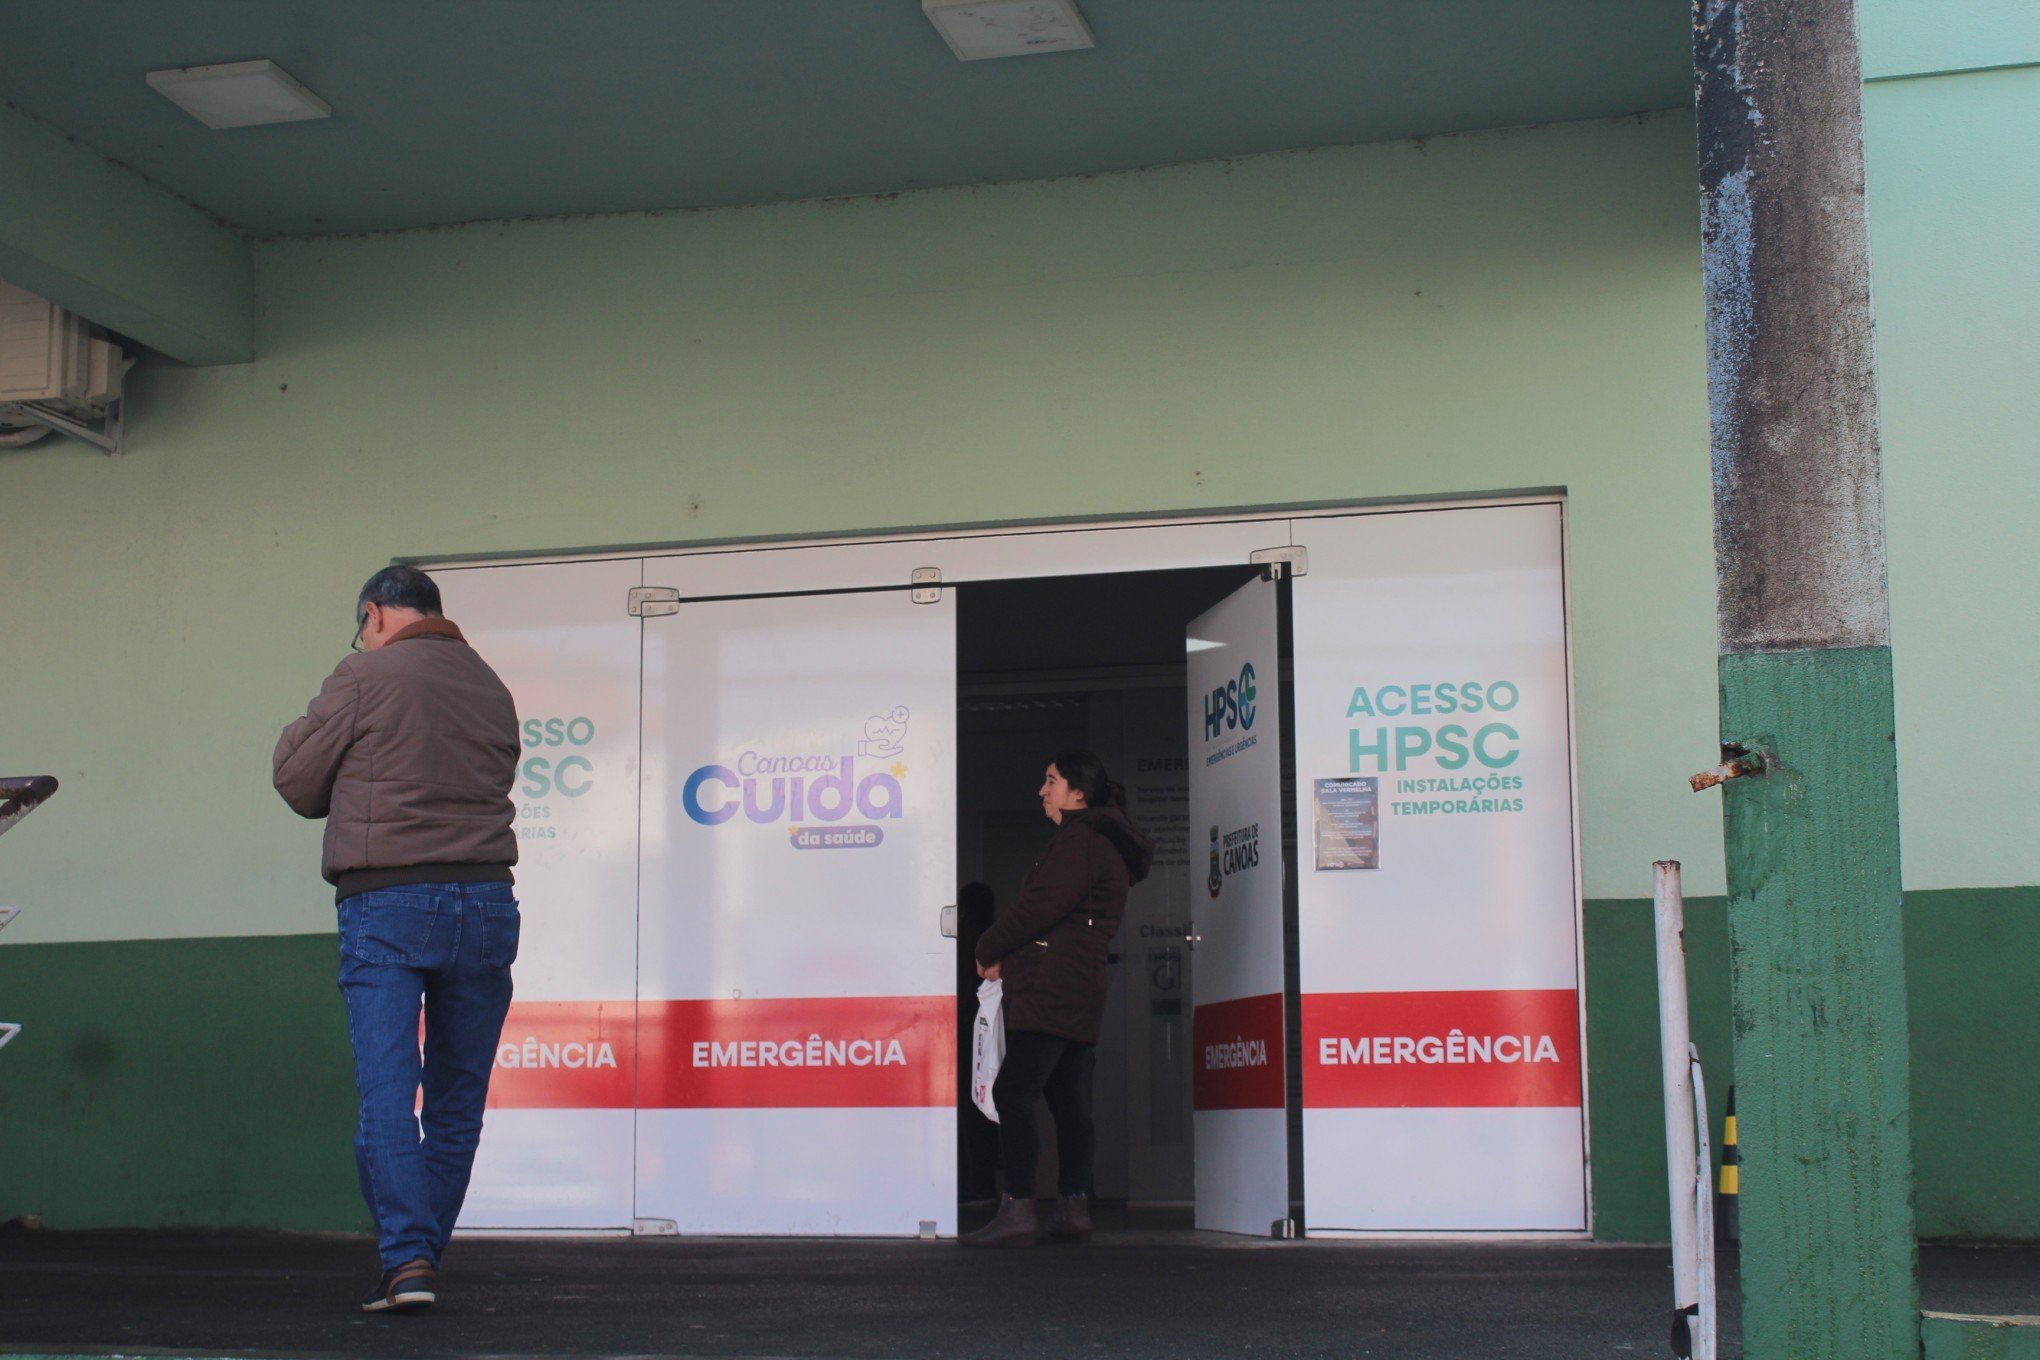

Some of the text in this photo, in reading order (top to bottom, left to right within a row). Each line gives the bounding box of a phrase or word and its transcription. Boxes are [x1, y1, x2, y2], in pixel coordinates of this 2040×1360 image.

[1345, 680, 1520, 718] ACESSO
[517, 716, 595, 748] SSO
[1349, 722, 1521, 773] HPSC
[514, 755, 595, 799] SC
[737, 750, 837, 777] Canoas
[682, 755, 903, 826] Cuida
[1396, 773, 1523, 795] INSTALAÇÕES
[1391, 795, 1524, 816] TEMPORÁRIAS
[798, 829, 876, 846] da saúde
[1251, 823, 1259, 839] DE
[1223, 839, 1259, 875] CANOAS
[492, 1036, 617, 1069] GÊNCIA
[692, 1034, 907, 1068] EMERGÊNCIA
[1205, 1035, 1267, 1070] EMERGÊNCIA
[1319, 1028, 1560, 1065] EMERGÊNCIA
